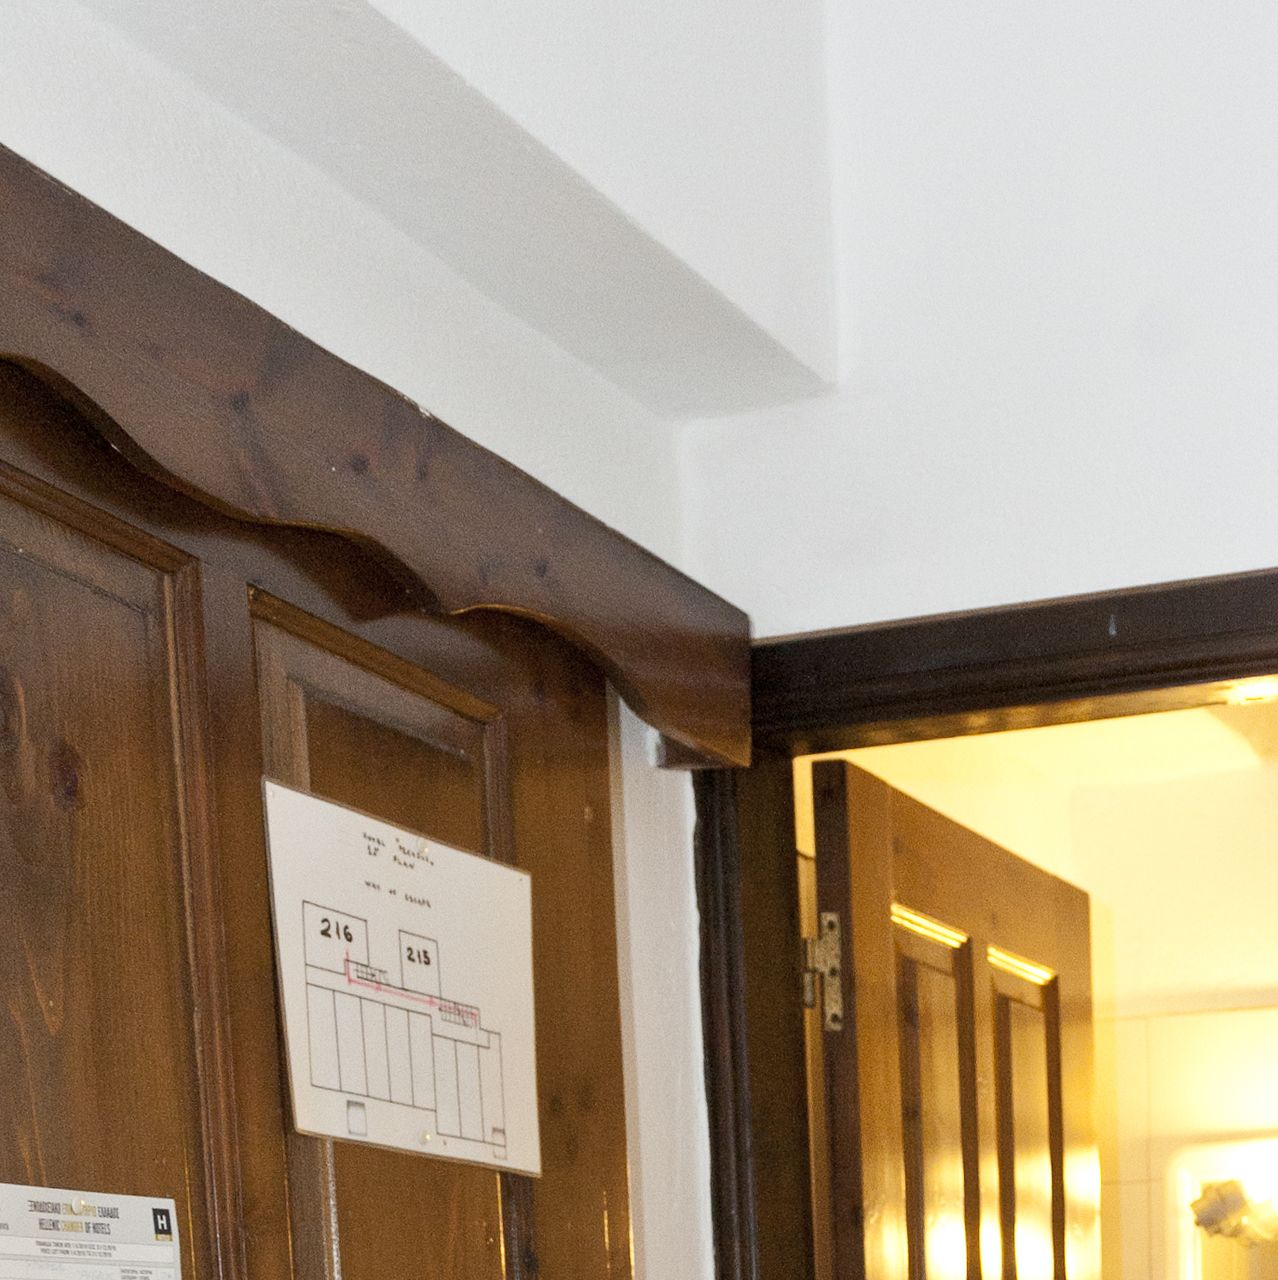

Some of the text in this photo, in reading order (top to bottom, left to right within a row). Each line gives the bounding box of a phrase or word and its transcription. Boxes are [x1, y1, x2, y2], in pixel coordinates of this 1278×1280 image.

[320, 918, 353, 943] 216
[406, 946, 431, 966] 215
[157, 1214, 168, 1230] H
